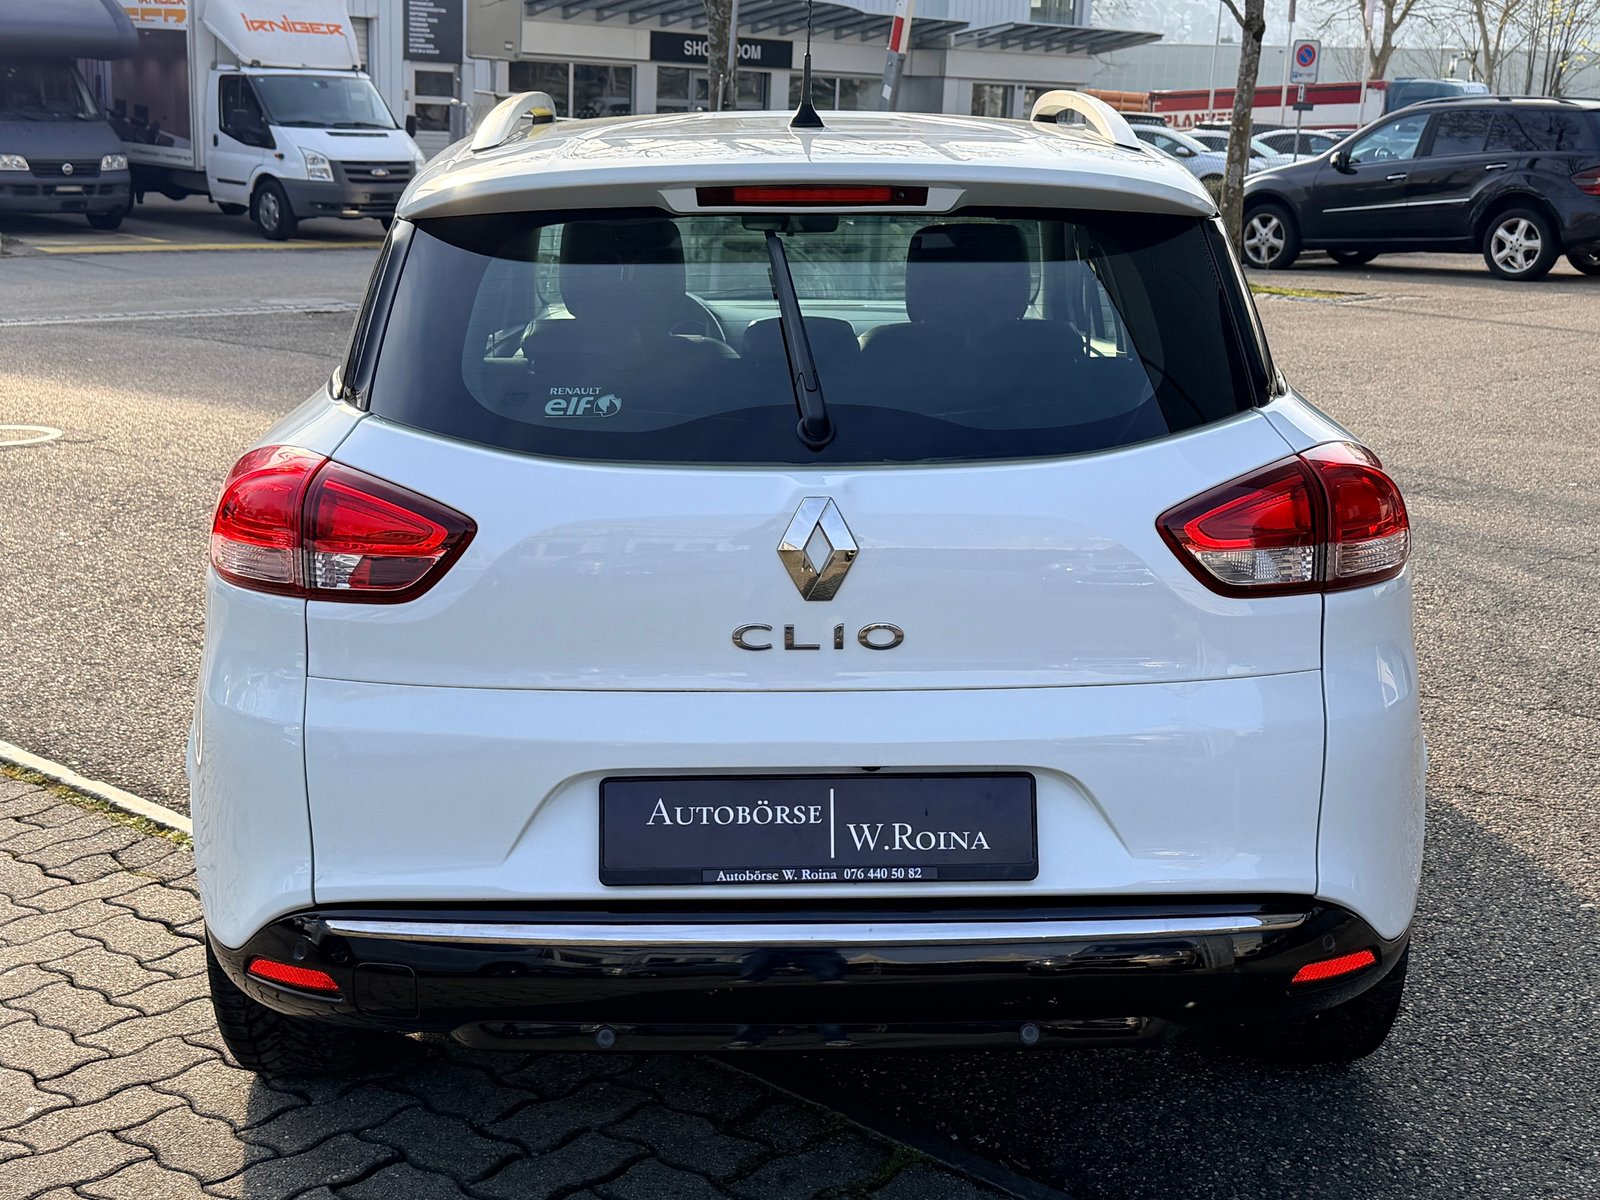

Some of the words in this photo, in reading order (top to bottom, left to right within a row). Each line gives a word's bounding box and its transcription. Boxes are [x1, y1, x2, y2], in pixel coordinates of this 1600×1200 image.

[684, 40, 761, 59] SHOOM
[550, 387, 602, 395] RENAULT
[544, 397, 594, 415] elf
[731, 622, 905, 651] CLIO
[716, 870, 779, 882] Autobörse
[782, 870, 798, 881] W.
[801, 869, 837, 881] Roina
[844, 869, 864, 880] 076
[867, 868, 888, 880] 440
[891, 868, 904, 880] 50
[908, 868, 922, 879] 82
